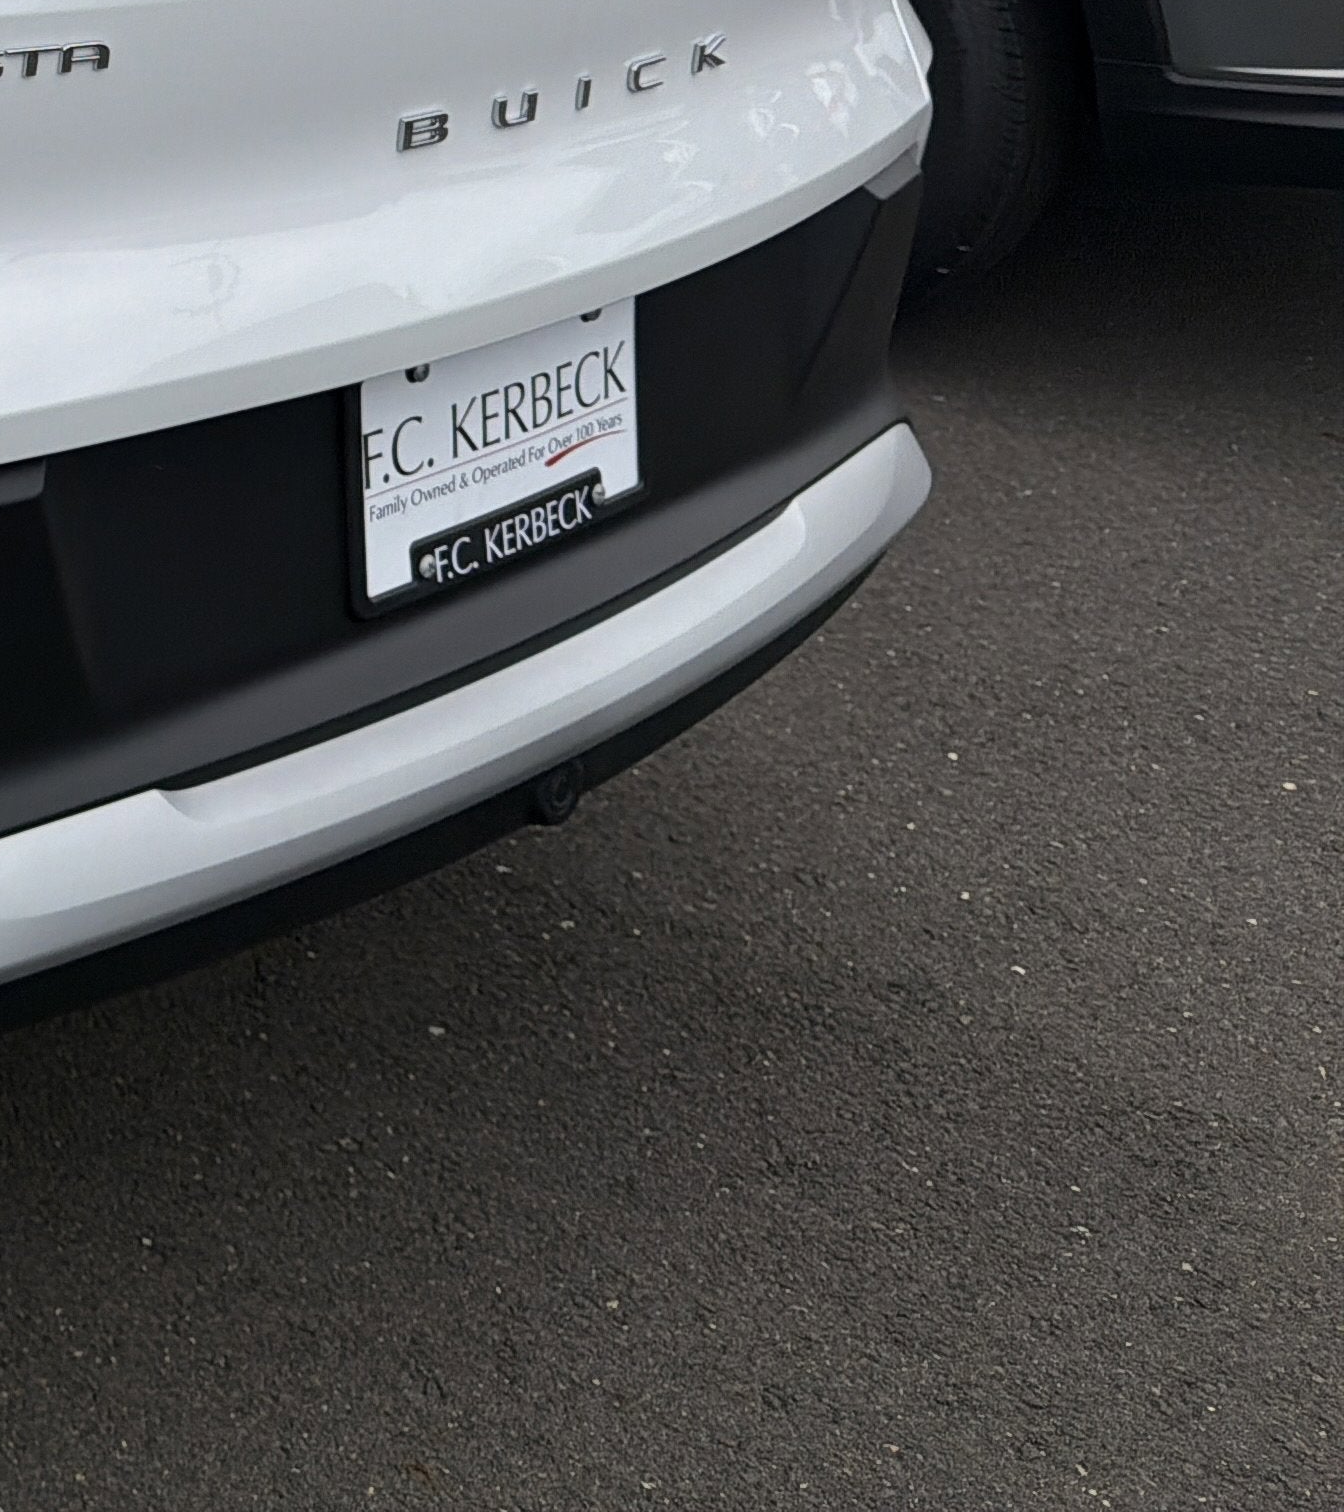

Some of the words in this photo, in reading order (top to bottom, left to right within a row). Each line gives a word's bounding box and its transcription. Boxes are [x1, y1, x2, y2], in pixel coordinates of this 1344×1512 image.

[396, 32, 727, 152] BUICK
[363, 415, 435, 490] F.C.
[450, 340, 627, 459] KERBECK
[369, 497, 408, 523] Family
[411, 481, 457, 507] Owned
[459, 472, 470, 489] &
[471, 454, 526, 486] Operated
[528, 446, 545, 464] For
[547, 436, 572, 455] Over
[576, 423, 595, 442] 100
[596, 413, 623, 434] Years
[433, 536, 480, 584] F.C.
[484, 486, 593, 564] KERBECK
